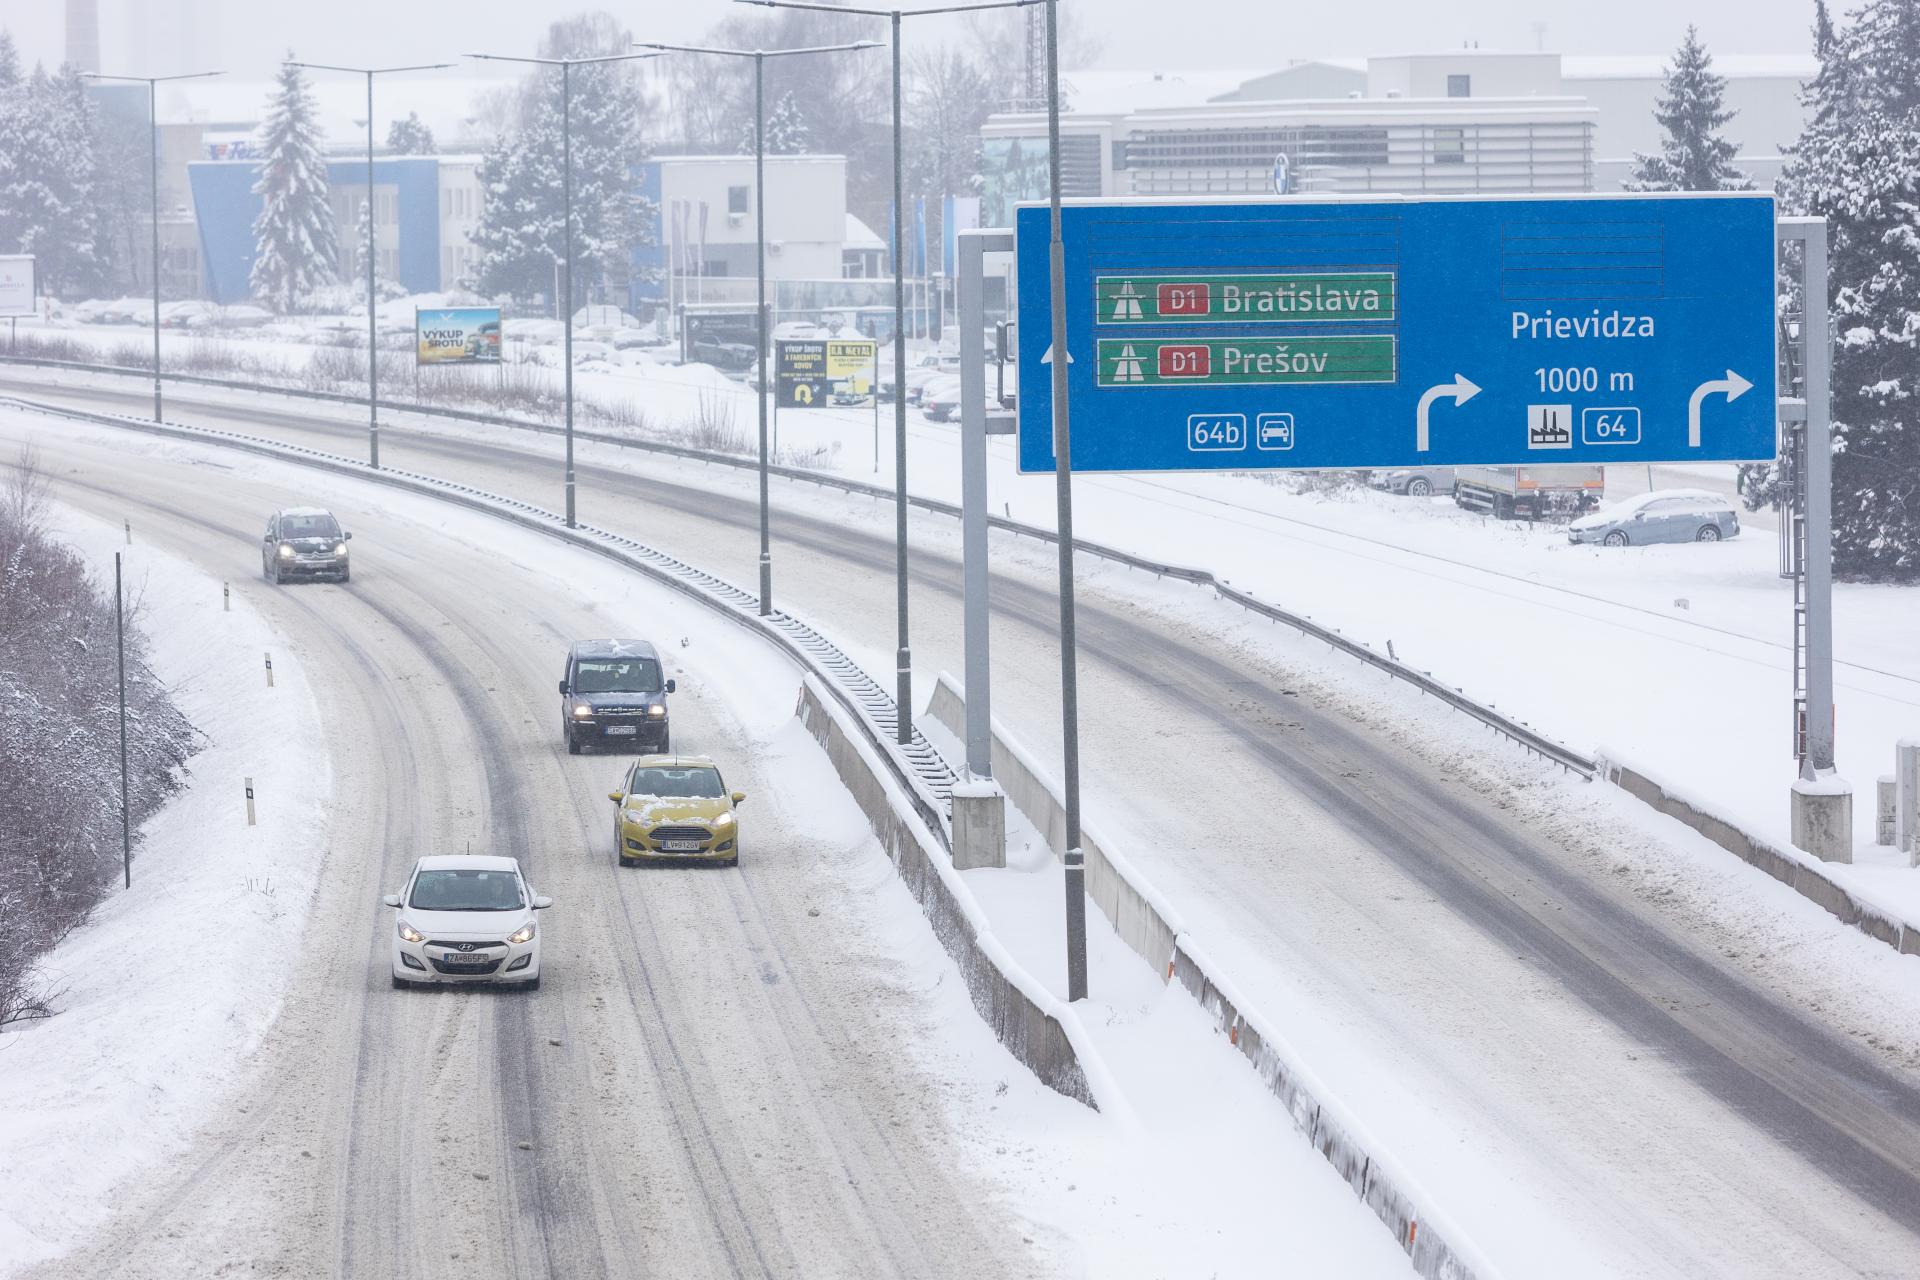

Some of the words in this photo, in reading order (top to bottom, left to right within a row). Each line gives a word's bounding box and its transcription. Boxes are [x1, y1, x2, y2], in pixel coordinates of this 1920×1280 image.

[1171, 289, 1197, 310] D1
[1223, 282, 1379, 313] Bratislava
[423, 328, 463, 339] VÝKUP
[1512, 309, 1655, 339] Prievidza
[1172, 351, 1198, 373] D1
[1224, 345, 1328, 374] Prešov
[1534, 367, 1598, 393] 1000
[1610, 372, 1634, 391] m
[1194, 421, 1240, 444] 64b
[1596, 414, 1626, 437] 64
